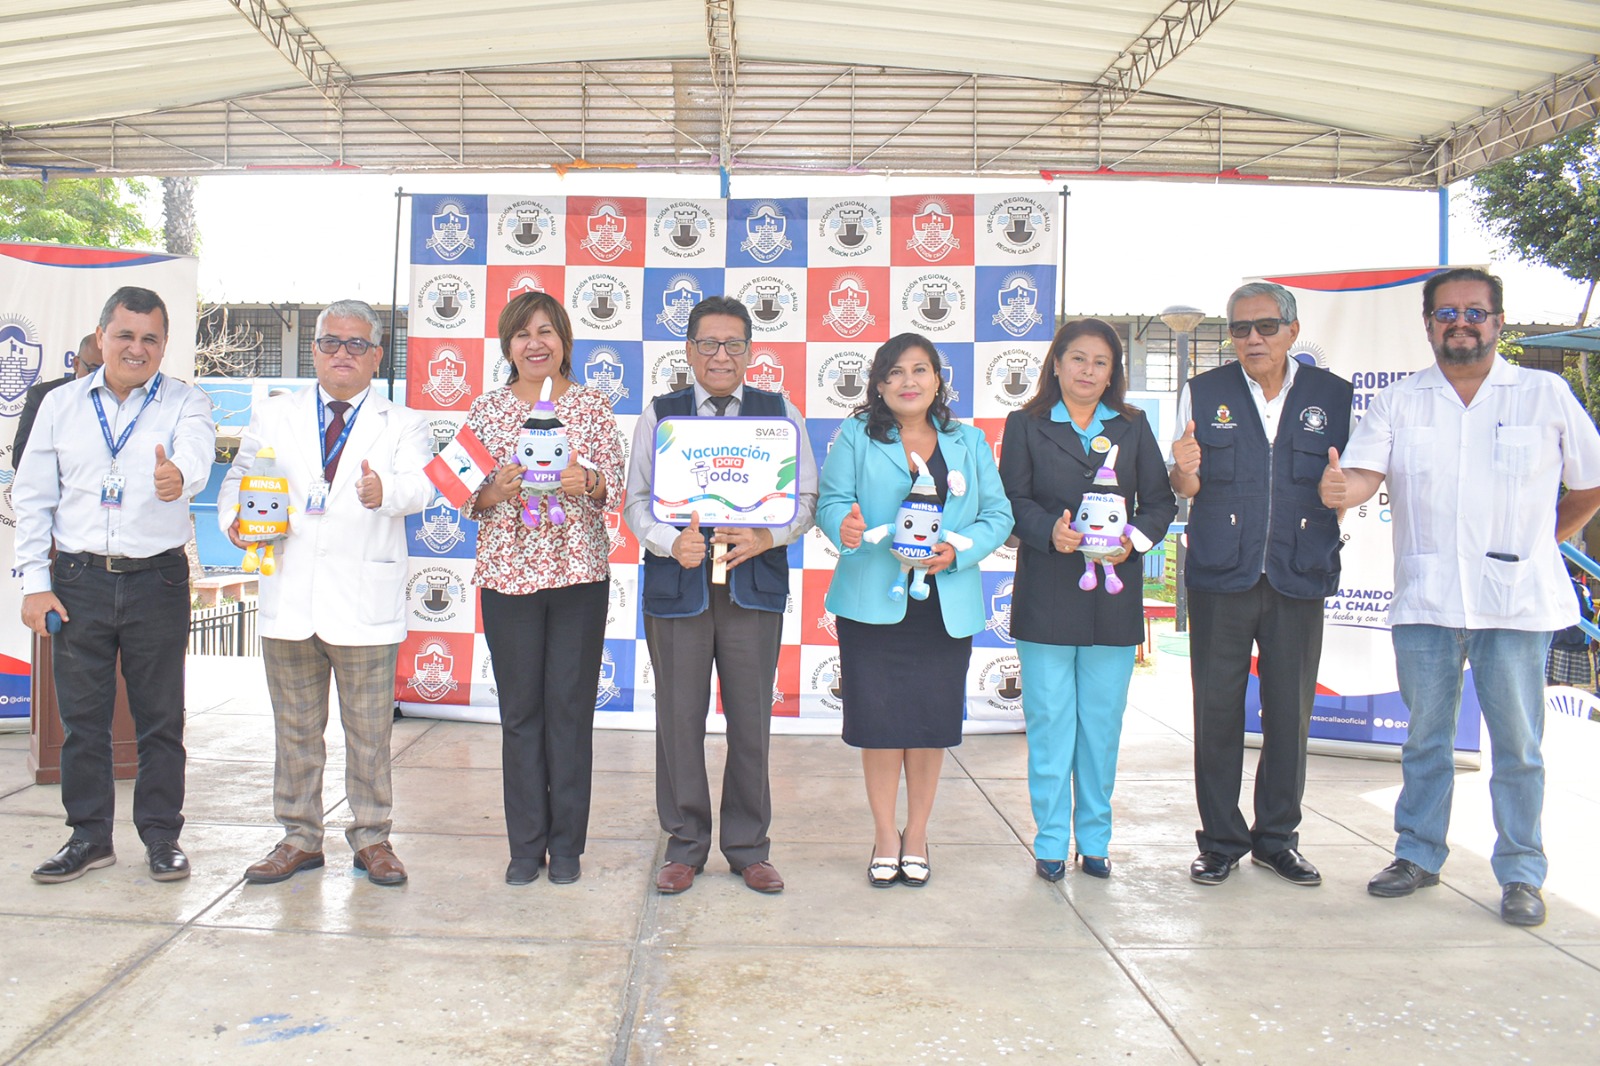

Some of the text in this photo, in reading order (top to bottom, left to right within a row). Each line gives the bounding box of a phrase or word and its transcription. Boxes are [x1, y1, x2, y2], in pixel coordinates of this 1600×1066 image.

[498, 206, 512, 236] DIRECCIÓN
[512, 200, 543, 210] REGIONAL
[654, 206, 669, 237] DIRECCIÓN
[670, 201, 701, 210] REGIONAL
[702, 209, 710, 218] DE
[820, 206, 835, 237] DIRECCIÓN
[835, 200, 867, 210] REGIONAL
[868, 208, 876, 216] DE
[987, 203, 1003, 234] DIRECCIÓN
[1004, 197, 1036, 206] REGIONAL
[505, 244, 546, 256] REGIÓN CALLAO
[662, 246, 705, 258] REGIÓN CALLAO
[828, 245, 872, 257] REGIÓN CALLAO
[996, 242, 1040, 254] REGIÓN CALLAO
[752, 276, 784, 285] REGIONAL
[418, 280, 434, 308] DIRECCIÓN
[434, 274, 463, 283] REGIONAL
[572, 280, 588, 308] DIRECCIÓN
[588, 274, 618, 283] REGIONAL
[618, 281, 627, 290] DE
[902, 280, 918, 310] DIRECCIÓN
[919, 274, 951, 283] REGIONAL
[952, 281, 961, 289] DE
[426, 317, 467, 329] REGIÓN CALLAO
[580, 317, 622, 330] REGIÓN CALLAO
[765, 321, 788, 332] CALLAO
[911, 319, 956, 332] REGIÓN CALLAO
[652, 354, 666, 384] DIRECCIÓN
[818, 356, 834, 387] DIRECCIÓN
[834, 351, 867, 359] REGIONAL
[986, 354, 1002, 385] DIRECCIÓN
[1003, 349, 1031, 358] REGIONAL
[429, 420, 459, 430] REGIONAL
[756, 428, 789, 436] SVA25
[682, 445, 770, 462] Vacunación
[715, 460, 742, 468] para
[250, 480, 282, 490] MINSA
[911, 503, 938, 512] MINSA
[248, 524, 276, 533] POLIO
[1085, 537, 1108, 546] VPH
[406, 572, 422, 601] DIRECCIÓN
[423, 567, 454, 576] REGIONAL
[1335, 589, 1393, 600] AJANDO
[413, 610, 456, 622] REGIÓN CALLAO
[1333, 611, 1353, 620] hecho
[812, 660, 828, 690] DIRECCIÓN
[979, 661, 996, 690] DIRECCIÓN
[820, 698, 841, 710] REGIÓN
[988, 699, 1008, 710] REGIÓN
